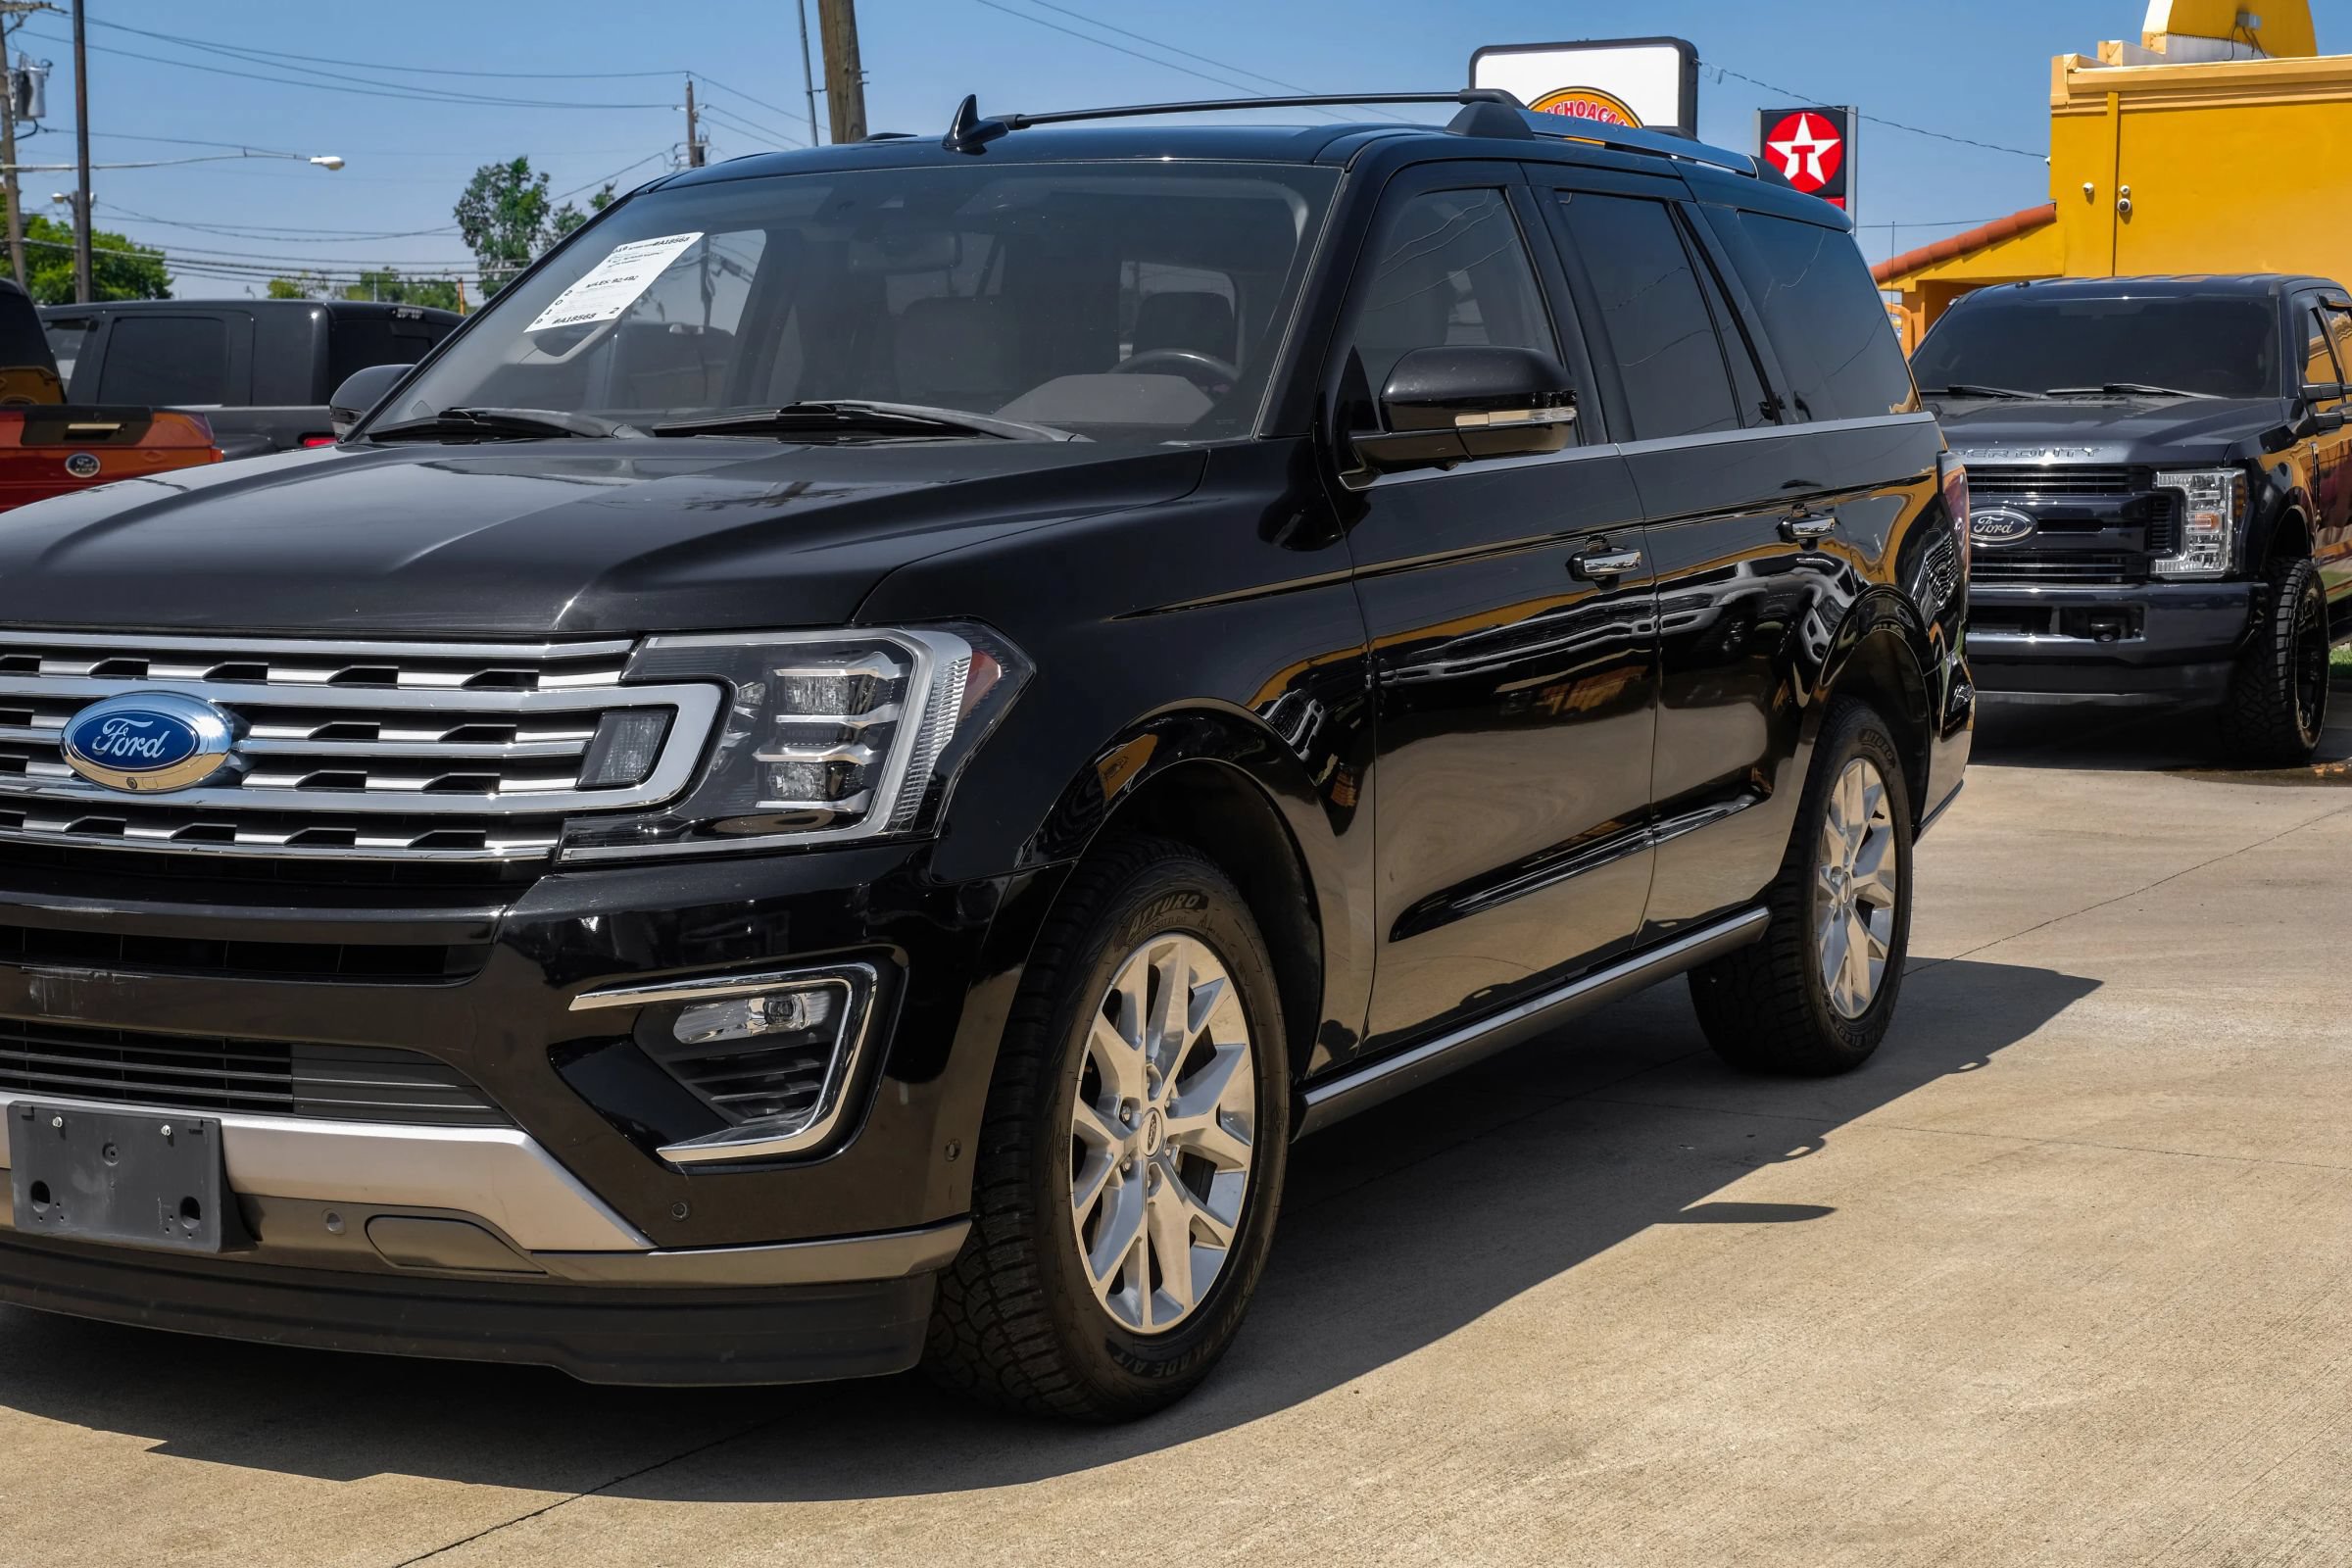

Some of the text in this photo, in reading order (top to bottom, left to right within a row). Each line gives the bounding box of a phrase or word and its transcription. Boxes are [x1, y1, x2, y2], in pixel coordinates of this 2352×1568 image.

[1791, 145, 1815, 172] T
[1972, 515, 2014, 535] Ford
[91, 717, 171, 759] Ford
